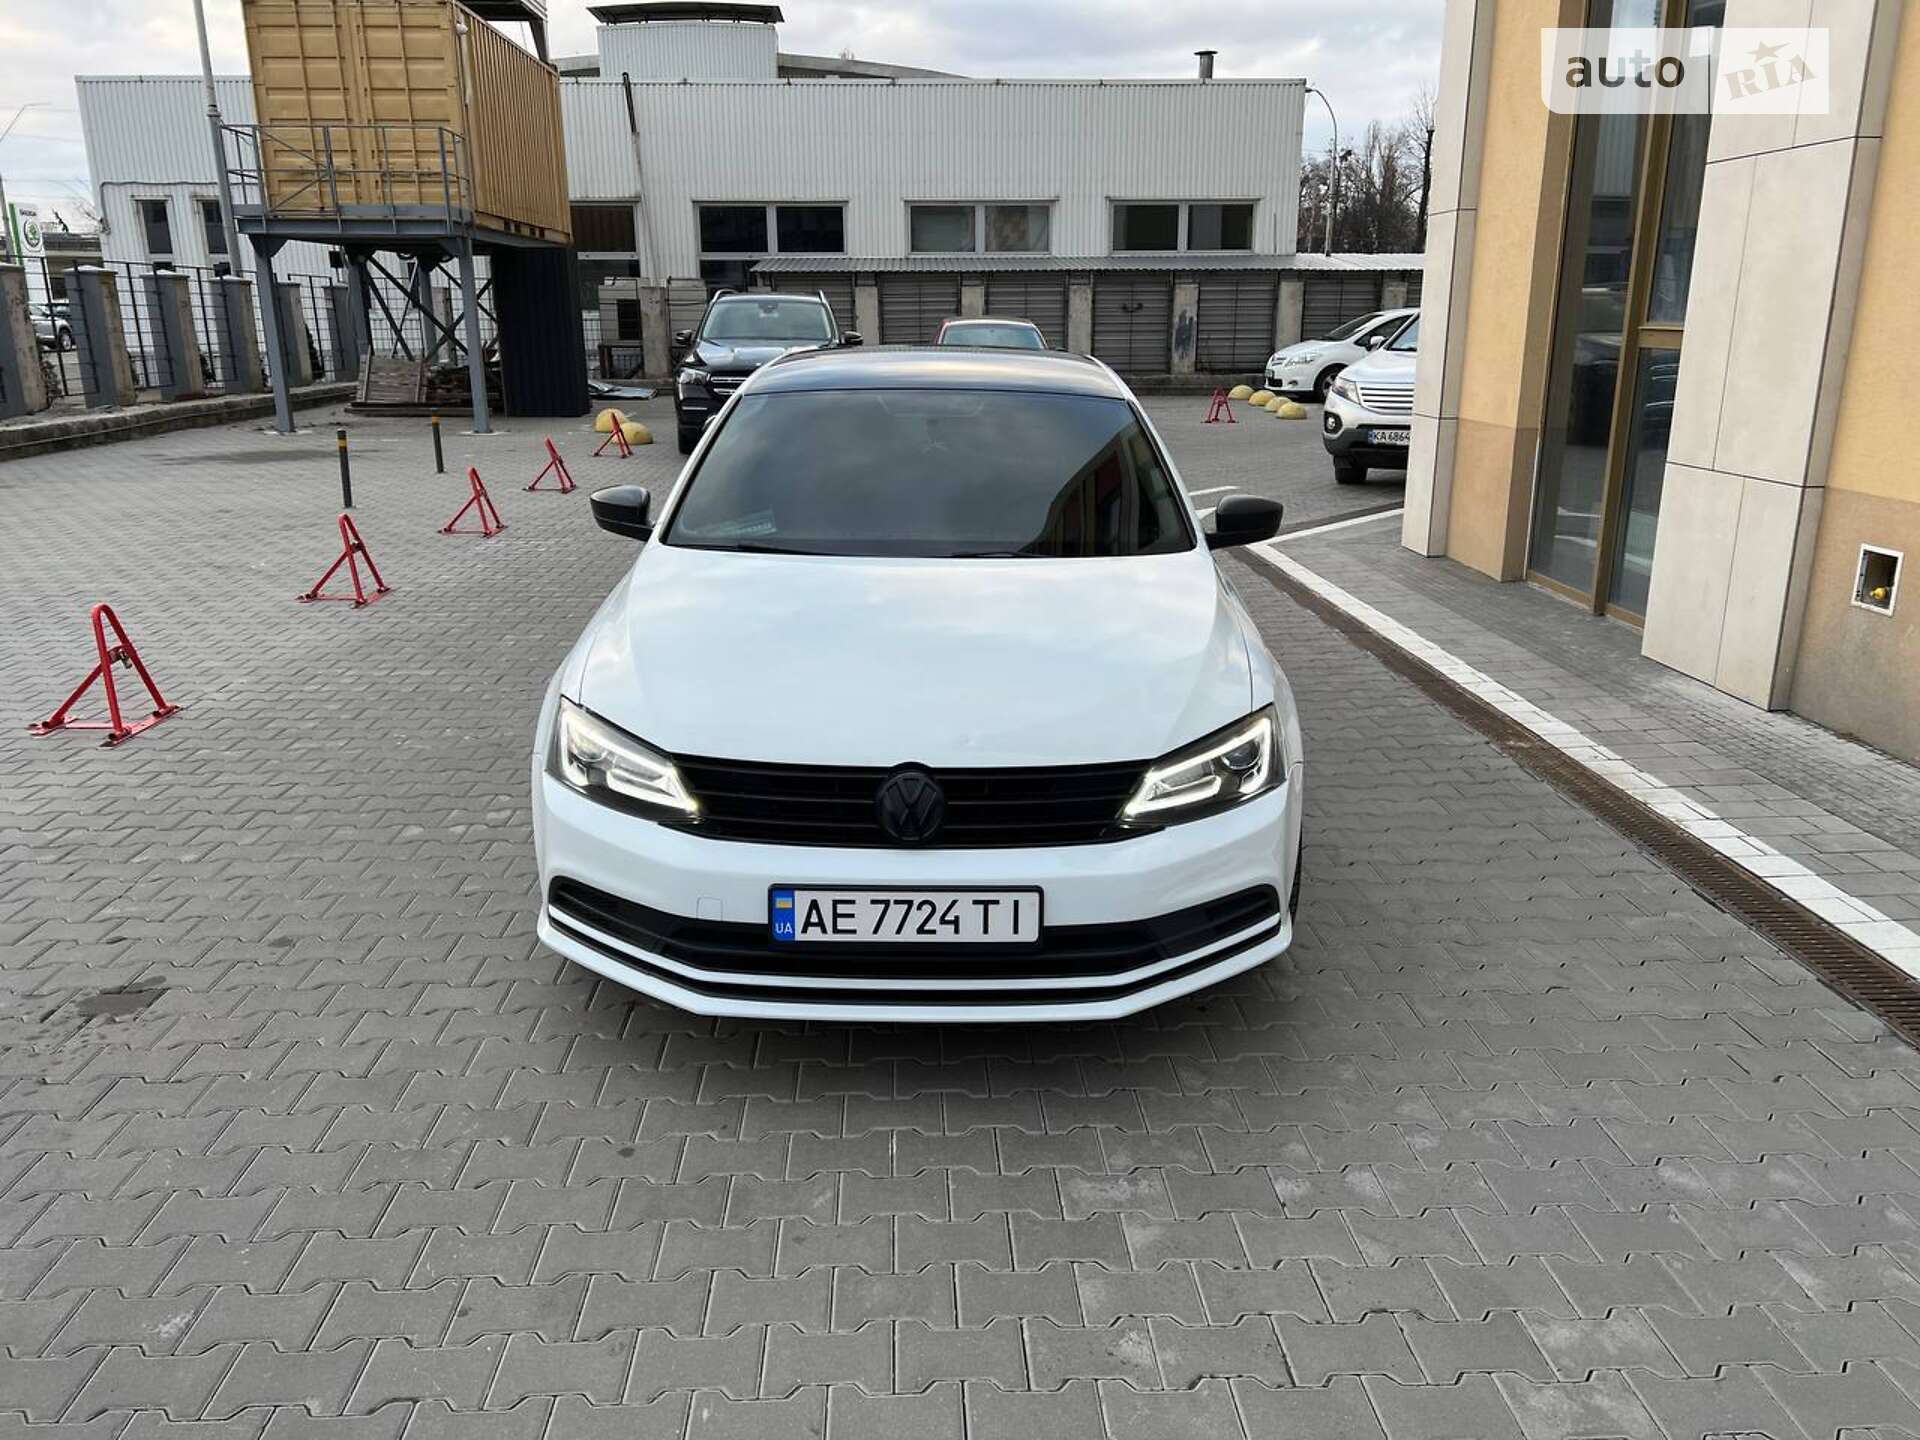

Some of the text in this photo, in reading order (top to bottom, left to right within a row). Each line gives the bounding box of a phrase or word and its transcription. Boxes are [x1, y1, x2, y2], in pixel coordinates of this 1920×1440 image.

[774, 922, 793, 934] UA
[801, 899, 1020, 935] AE 7724 TI
